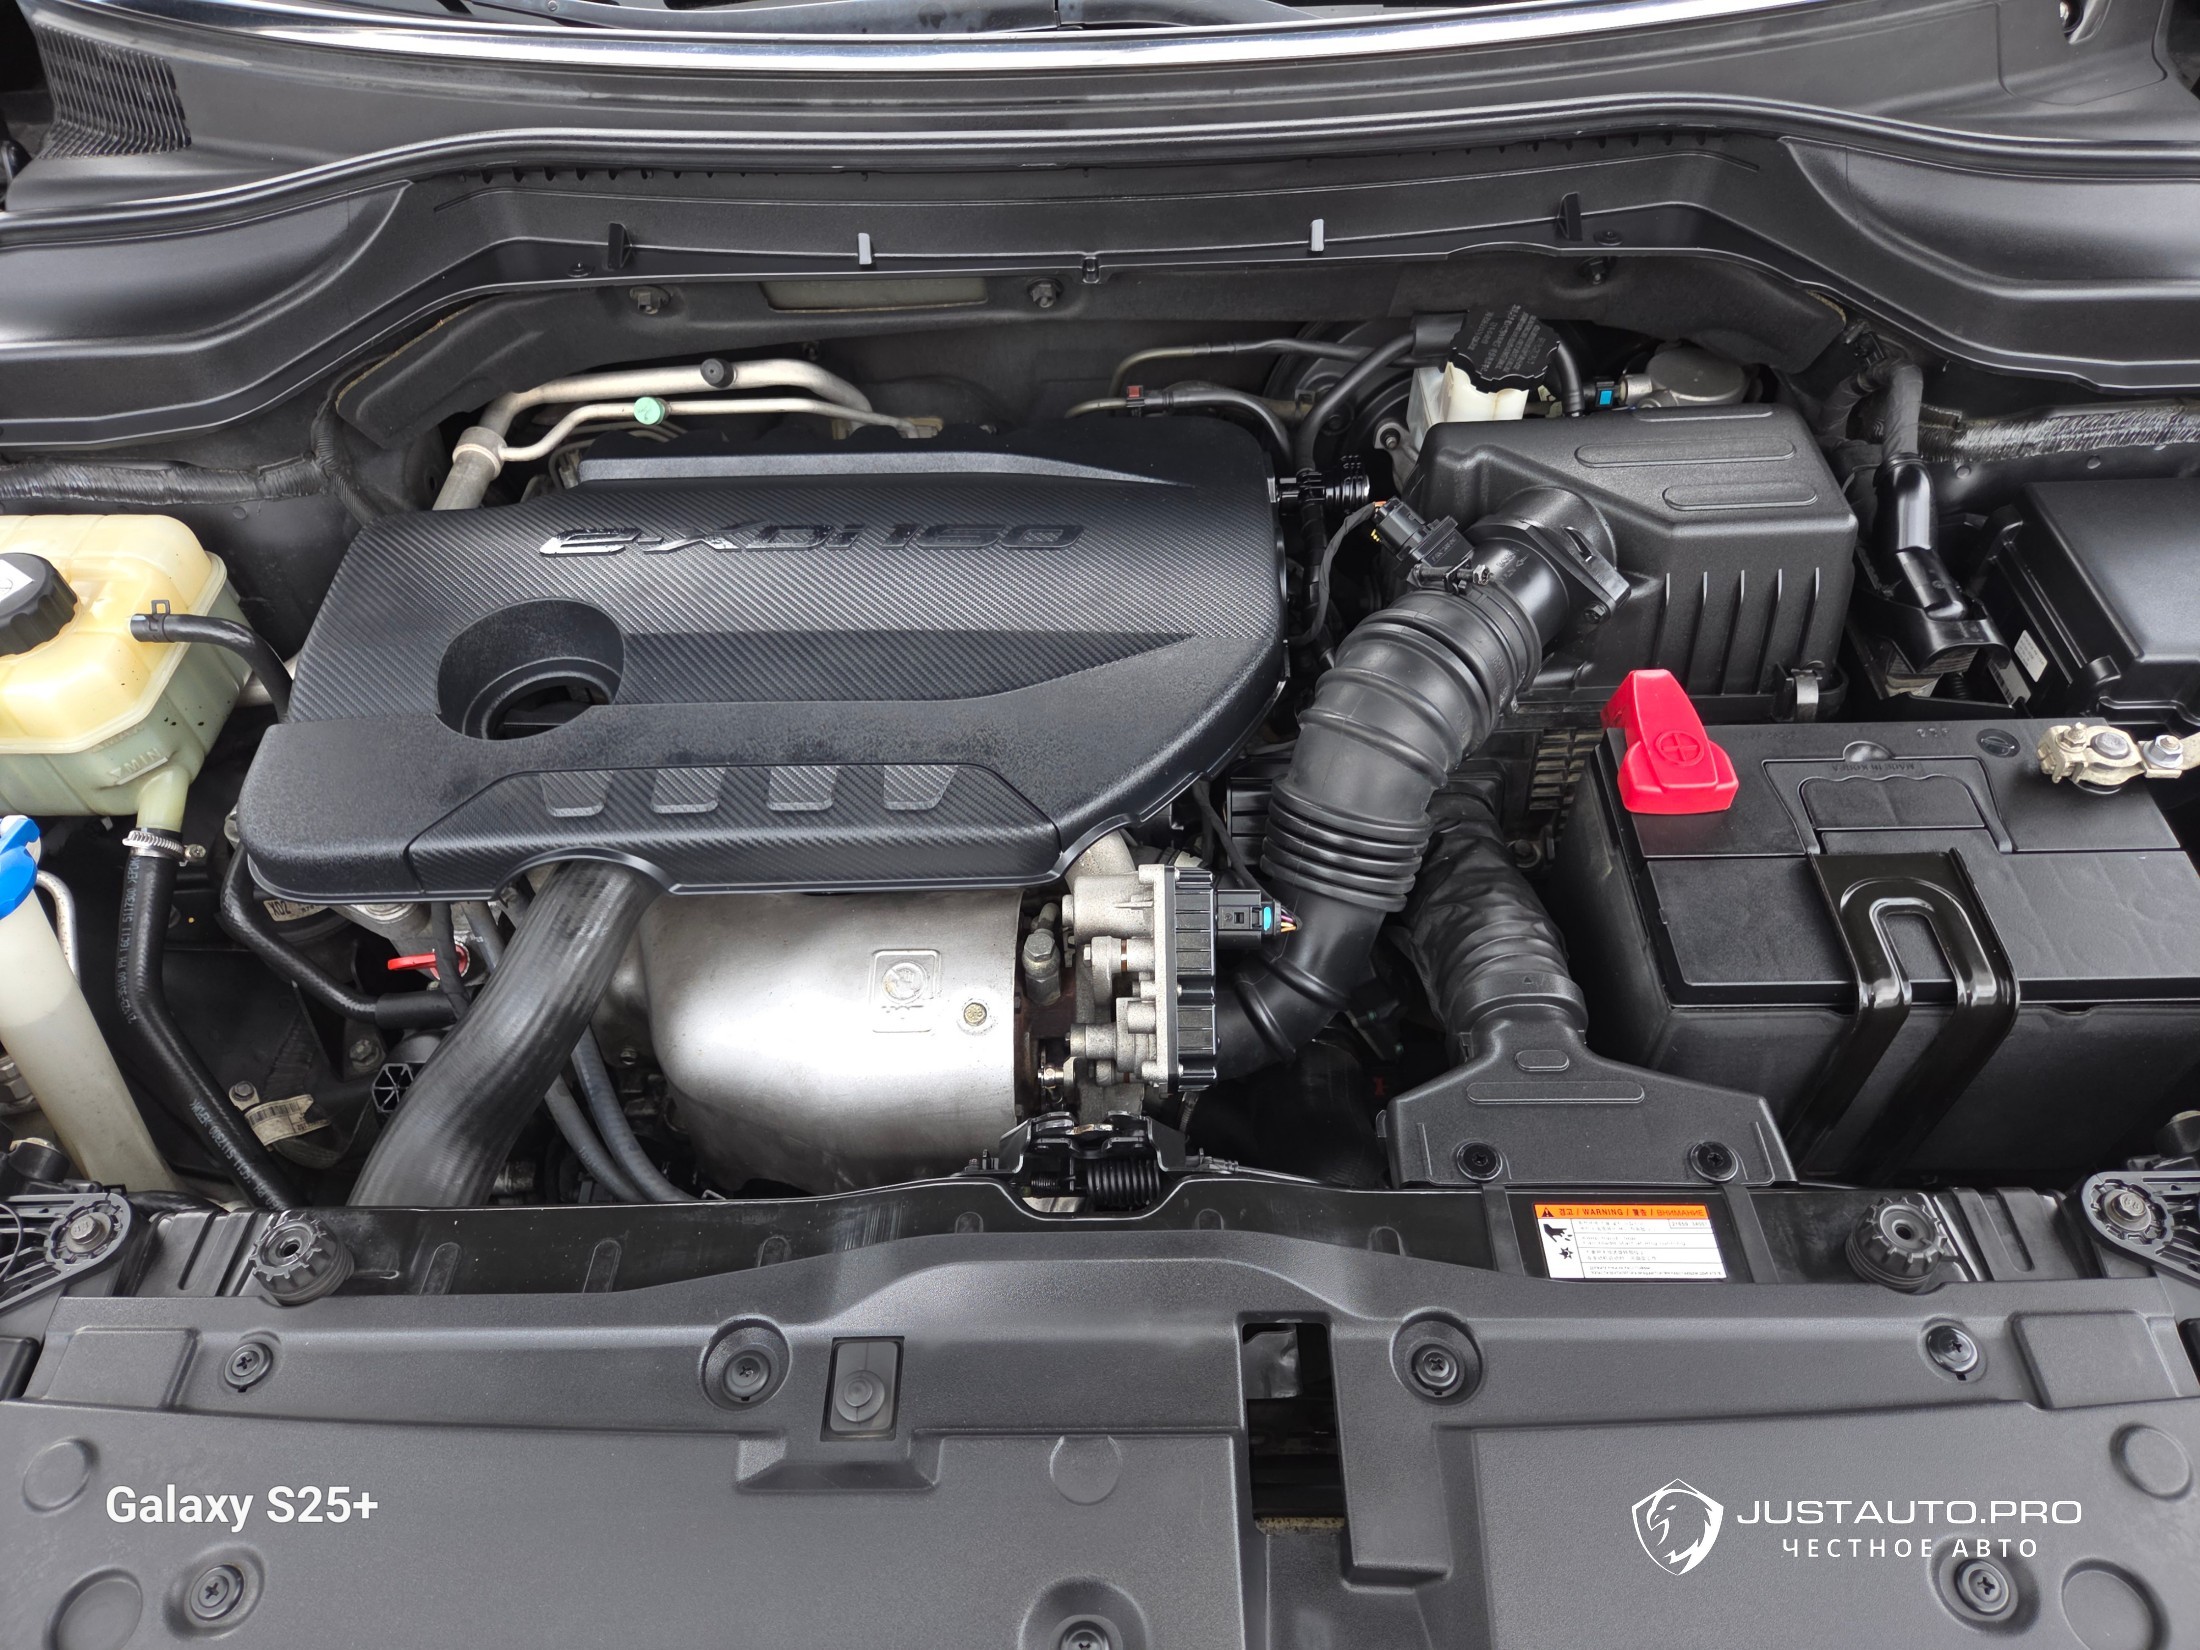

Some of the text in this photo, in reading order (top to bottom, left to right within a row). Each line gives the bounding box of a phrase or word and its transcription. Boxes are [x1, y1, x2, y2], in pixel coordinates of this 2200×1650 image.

[124, 747, 161, 774] MIN
[122, 887, 138, 922] 5117300
[209, 1126, 237, 1160] 5117300
[1559, 1207, 1574, 1216] 경고
[1582, 1208, 1623, 1216] WARNING
[1656, 1209, 1704, 1217] ВНИМАНИЕ
